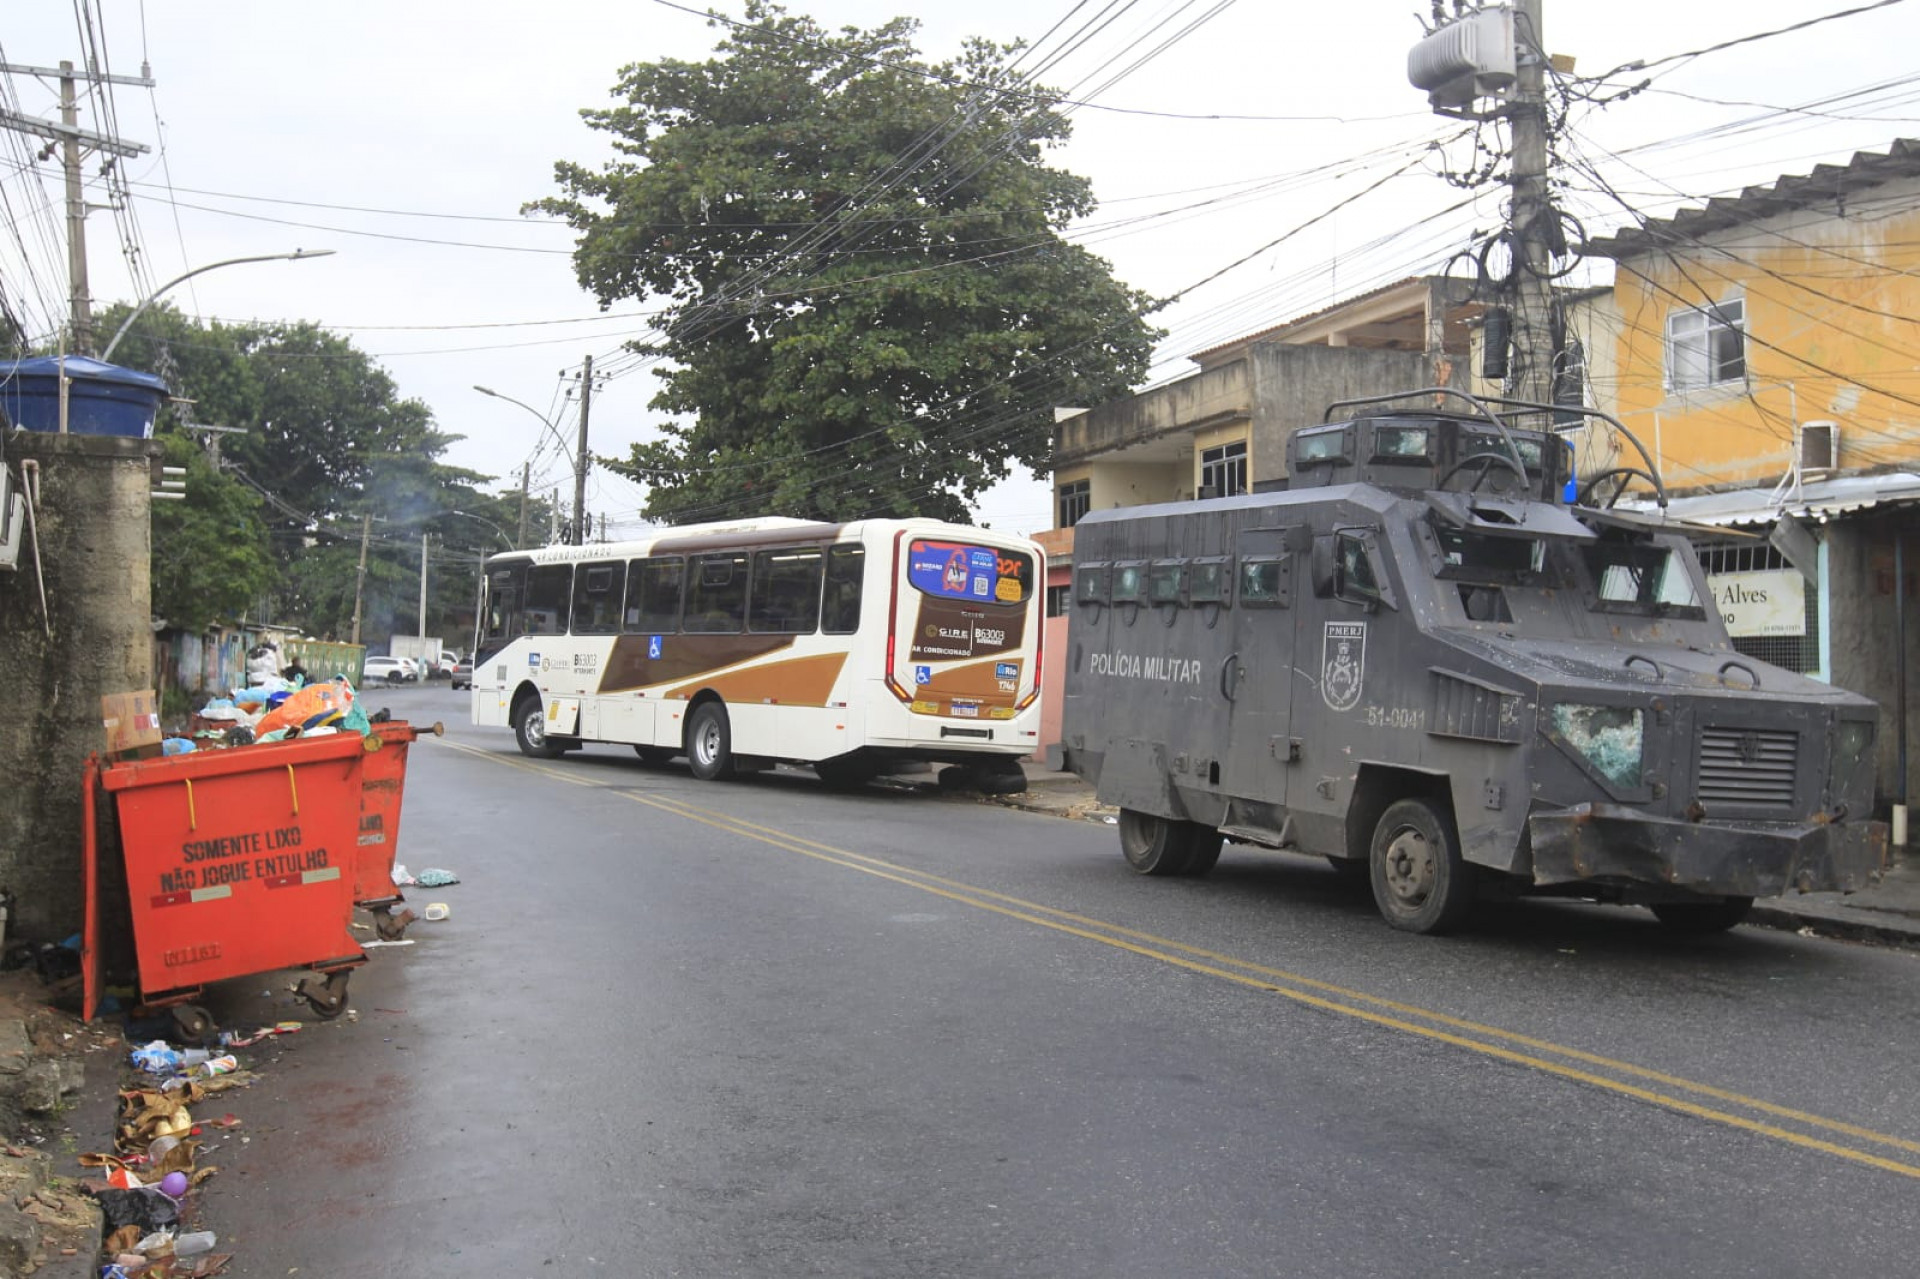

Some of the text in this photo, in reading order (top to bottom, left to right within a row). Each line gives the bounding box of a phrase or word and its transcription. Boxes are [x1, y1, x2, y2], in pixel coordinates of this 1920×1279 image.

[1722, 583, 1768, 604] Alves
[975, 628, 1005, 641] B63003
[1328, 626, 1362, 636] PMERJ
[911, 645, 972, 656] AR CONDICIONADO
[1004, 666, 1018, 676] Rio
[1090, 650, 1201, 685] POLÍCIA MILITAR
[1367, 707, 1426, 729] 51-0041
[182, 826, 302, 863] SOMENTE LIXO
[160, 848, 329, 893] NÃO JOGUE ENTULHO
